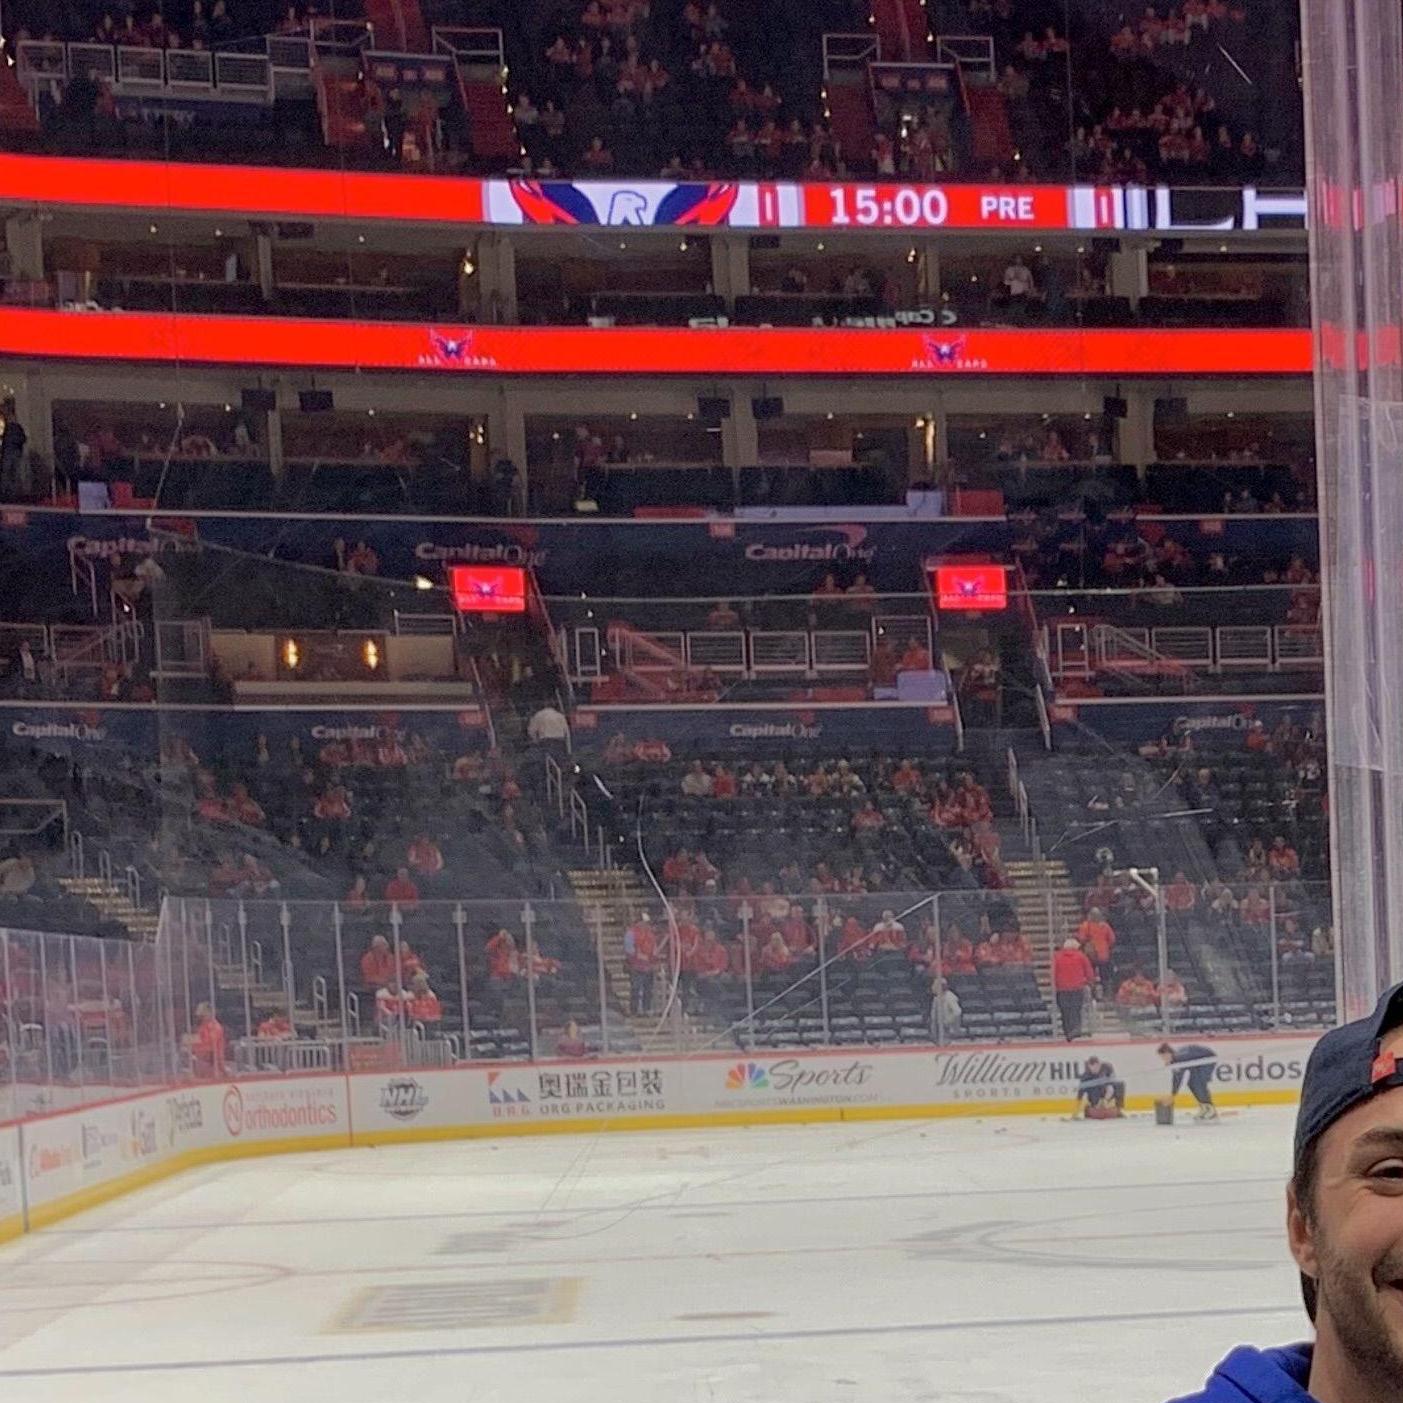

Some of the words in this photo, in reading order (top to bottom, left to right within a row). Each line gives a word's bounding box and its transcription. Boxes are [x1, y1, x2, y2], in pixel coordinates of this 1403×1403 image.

[829, 186, 949, 224] 15:00
[980, 195, 1034, 220] PRE
[769, 1058, 874, 1094] Sports
[935, 1052, 1047, 1086] William
[1049, 1061, 1083, 1082] HIL
[953, 1087, 1021, 1099] SPORTS
[245, 1104, 337, 1130] orthodontics
[539, 1102, 571, 1115] ORG
[576, 1098, 665, 1113] PACKAGING
